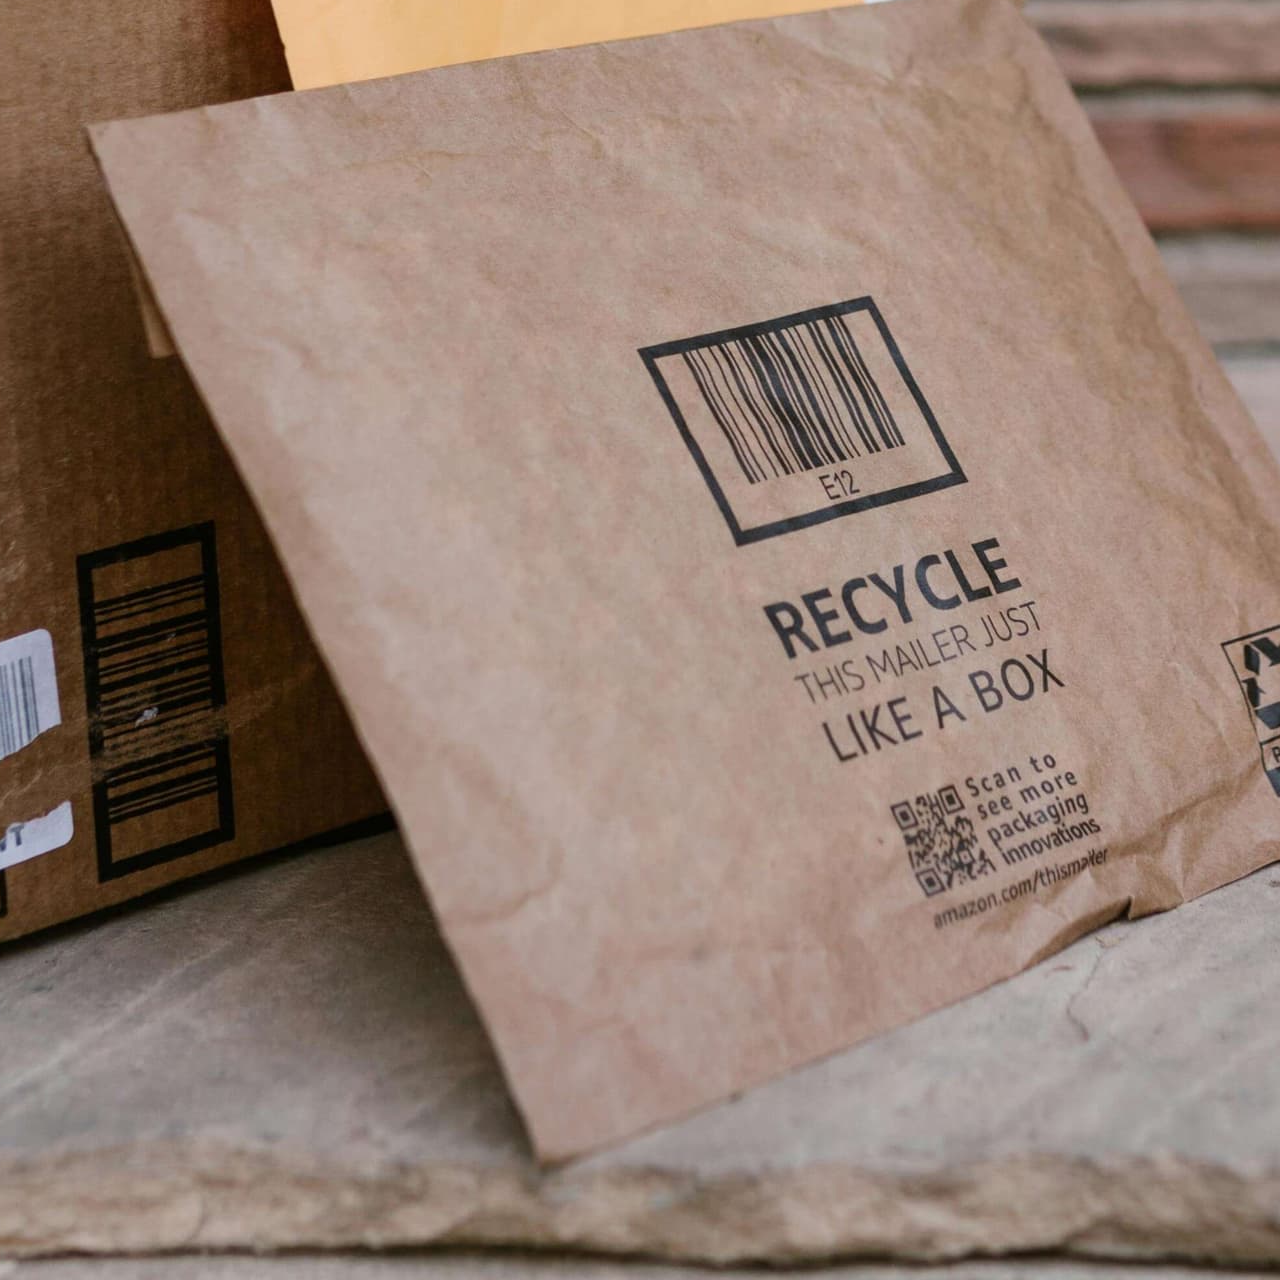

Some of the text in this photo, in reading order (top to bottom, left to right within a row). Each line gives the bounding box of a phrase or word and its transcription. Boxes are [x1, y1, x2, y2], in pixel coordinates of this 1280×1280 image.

[818, 469, 861, 501] E12
[762, 536, 1022, 660] RECYCLE
[794, 600, 1043, 705] THIS MAILER JUST
[822, 647, 1066, 763] LIKE A BOX
[965, 753, 1057, 798] Scan to
[977, 771, 1078, 820] see more
[987, 792, 1090, 849] packaging
[999, 818, 1102, 866] innovations
